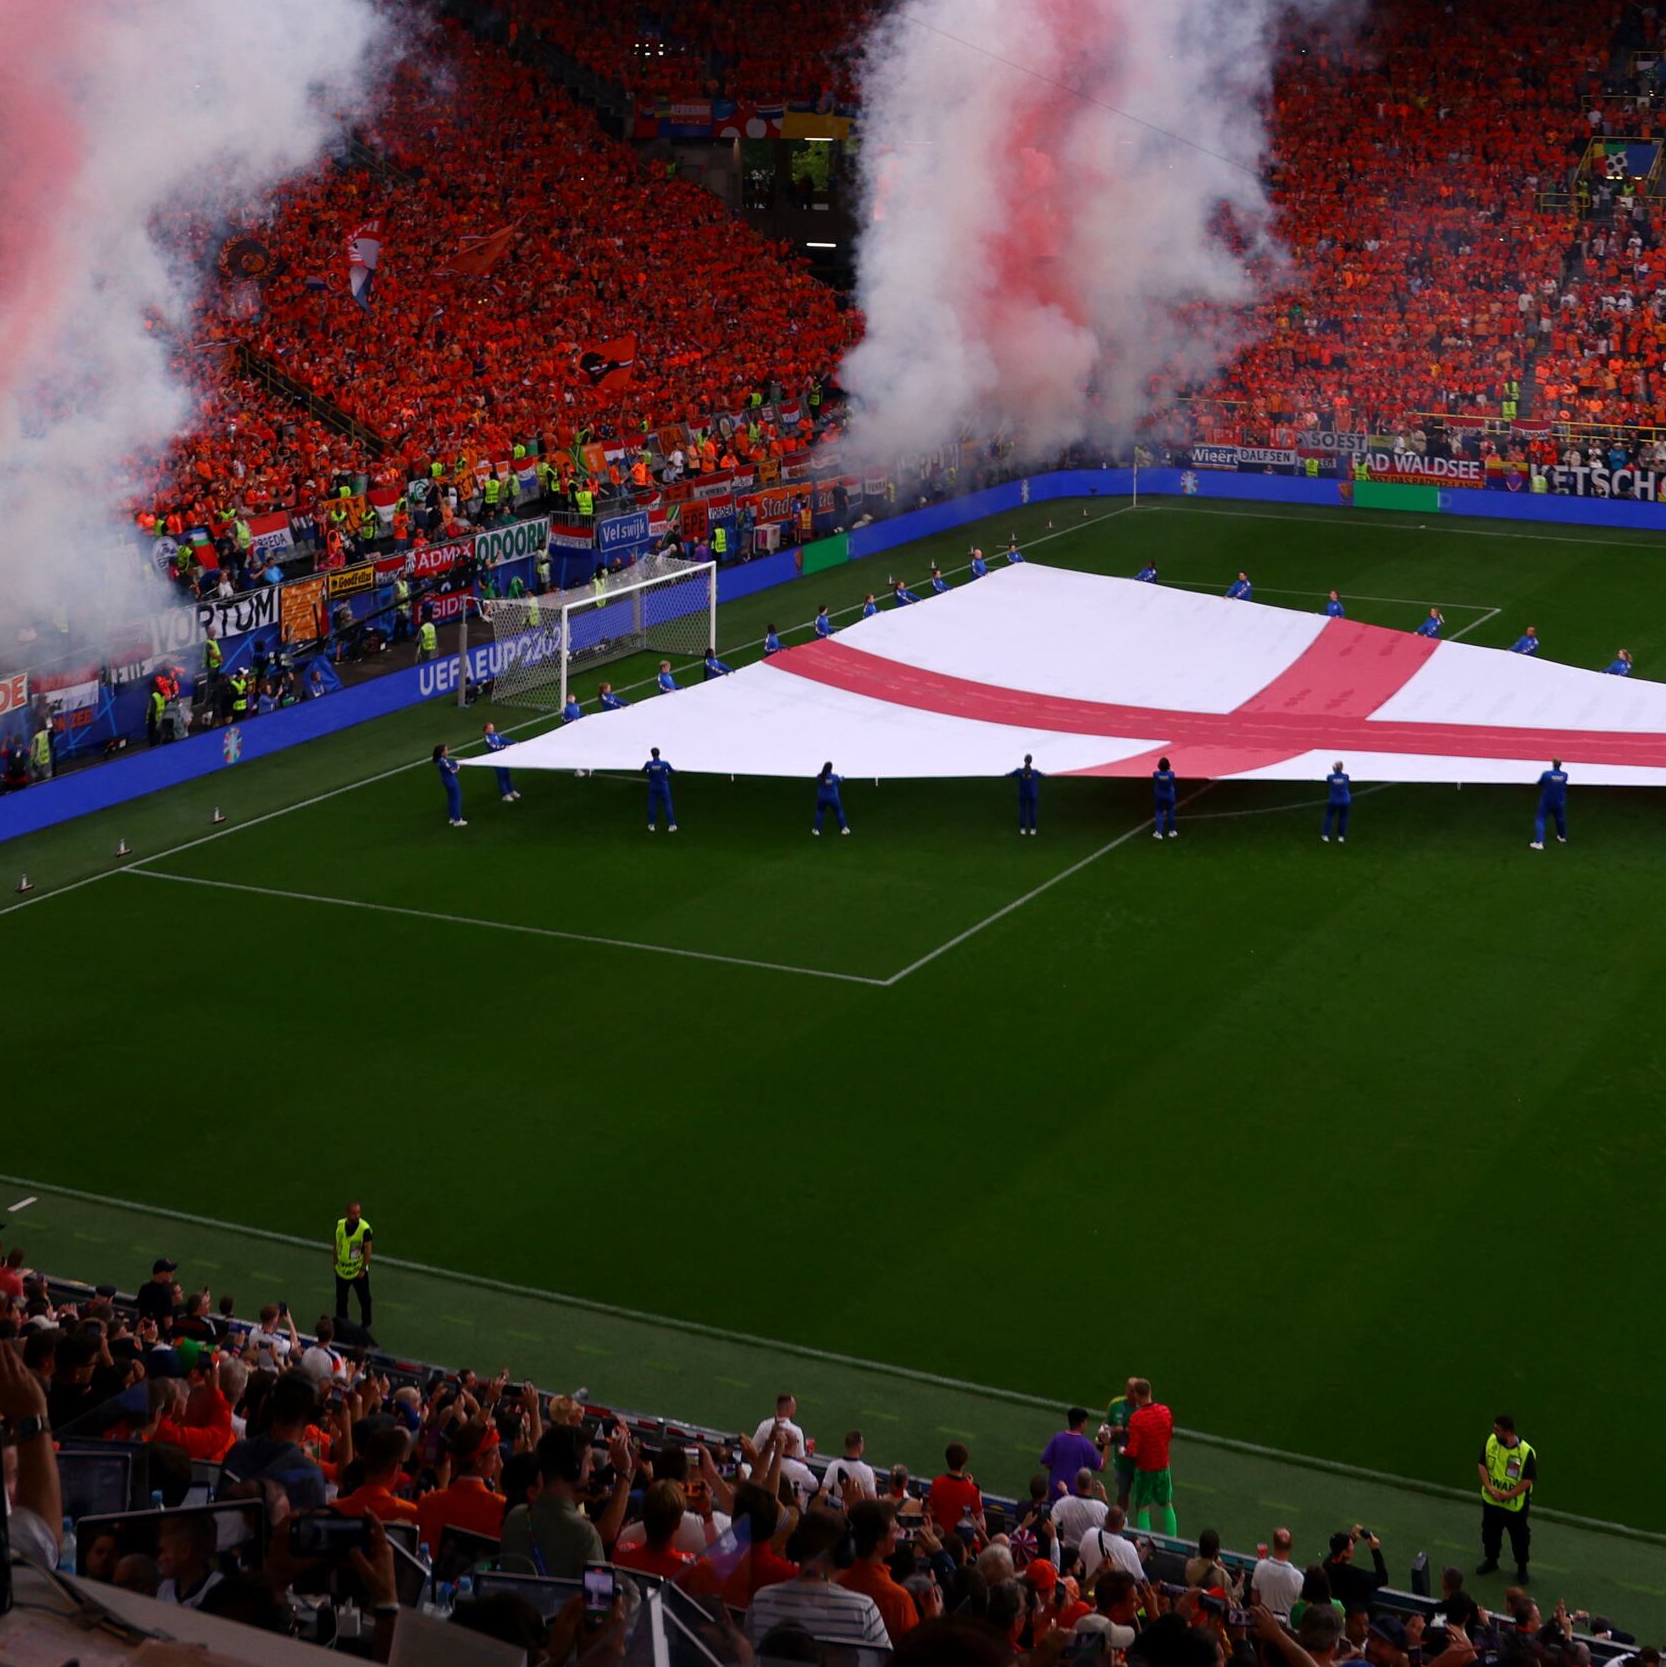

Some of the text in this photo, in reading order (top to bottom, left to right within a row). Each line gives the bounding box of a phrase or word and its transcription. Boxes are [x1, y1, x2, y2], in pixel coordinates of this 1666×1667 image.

[1240, 448, 1291, 463] DALFSEN
[1393, 454, 1480, 480] WALDSEE
[477, 520, 548, 566] ODOORN
[602, 516, 647, 543] Velswijk
[419, 624, 572, 697] UEFAEURO202
